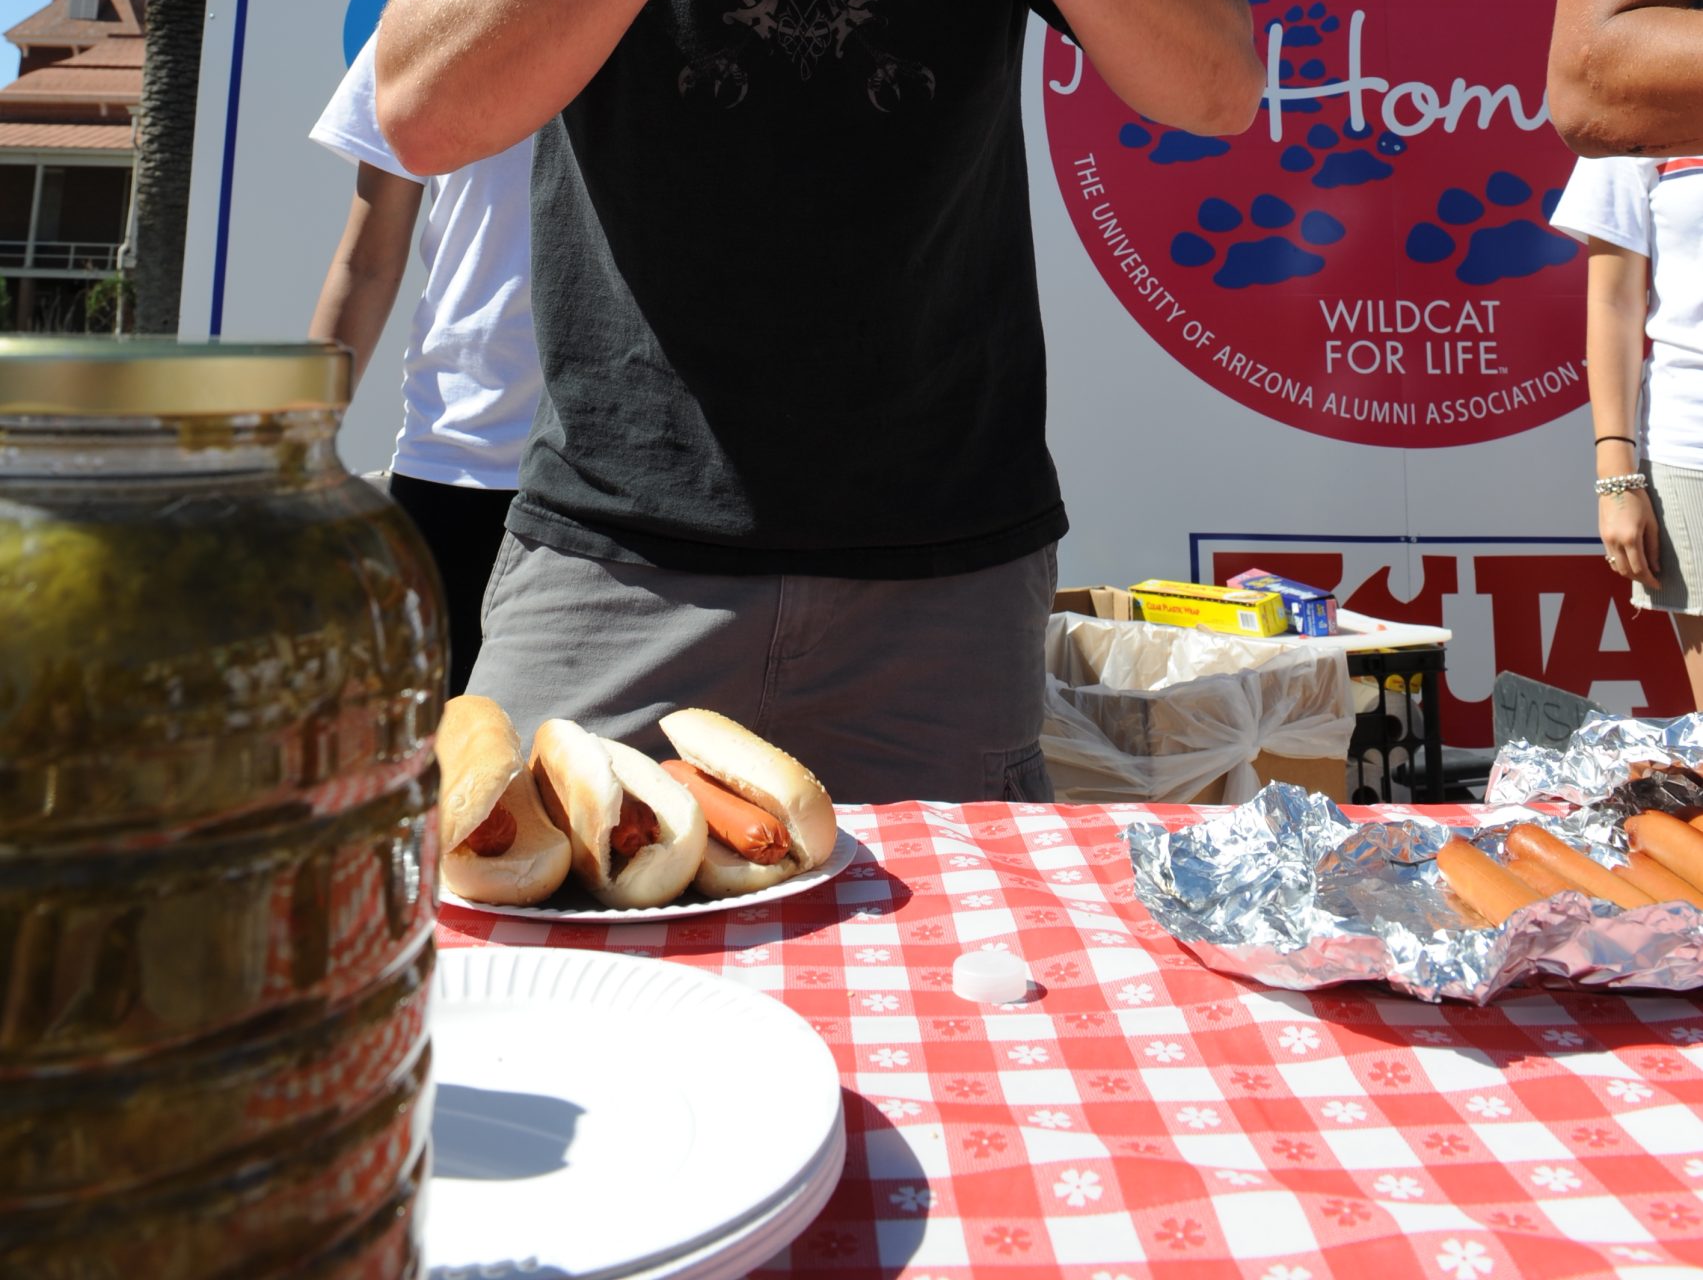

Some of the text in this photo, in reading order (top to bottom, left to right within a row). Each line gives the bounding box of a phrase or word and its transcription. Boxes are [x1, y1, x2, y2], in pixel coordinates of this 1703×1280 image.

[1263, 9, 1550, 143] Hom
[1074, 152, 1580, 426] THE UNIVERSITY OF ARIZONA ALUMNI ASSOCIATION
[1318, 298, 1501, 334] WILDCAT
[1325, 339, 1407, 375] FOR
